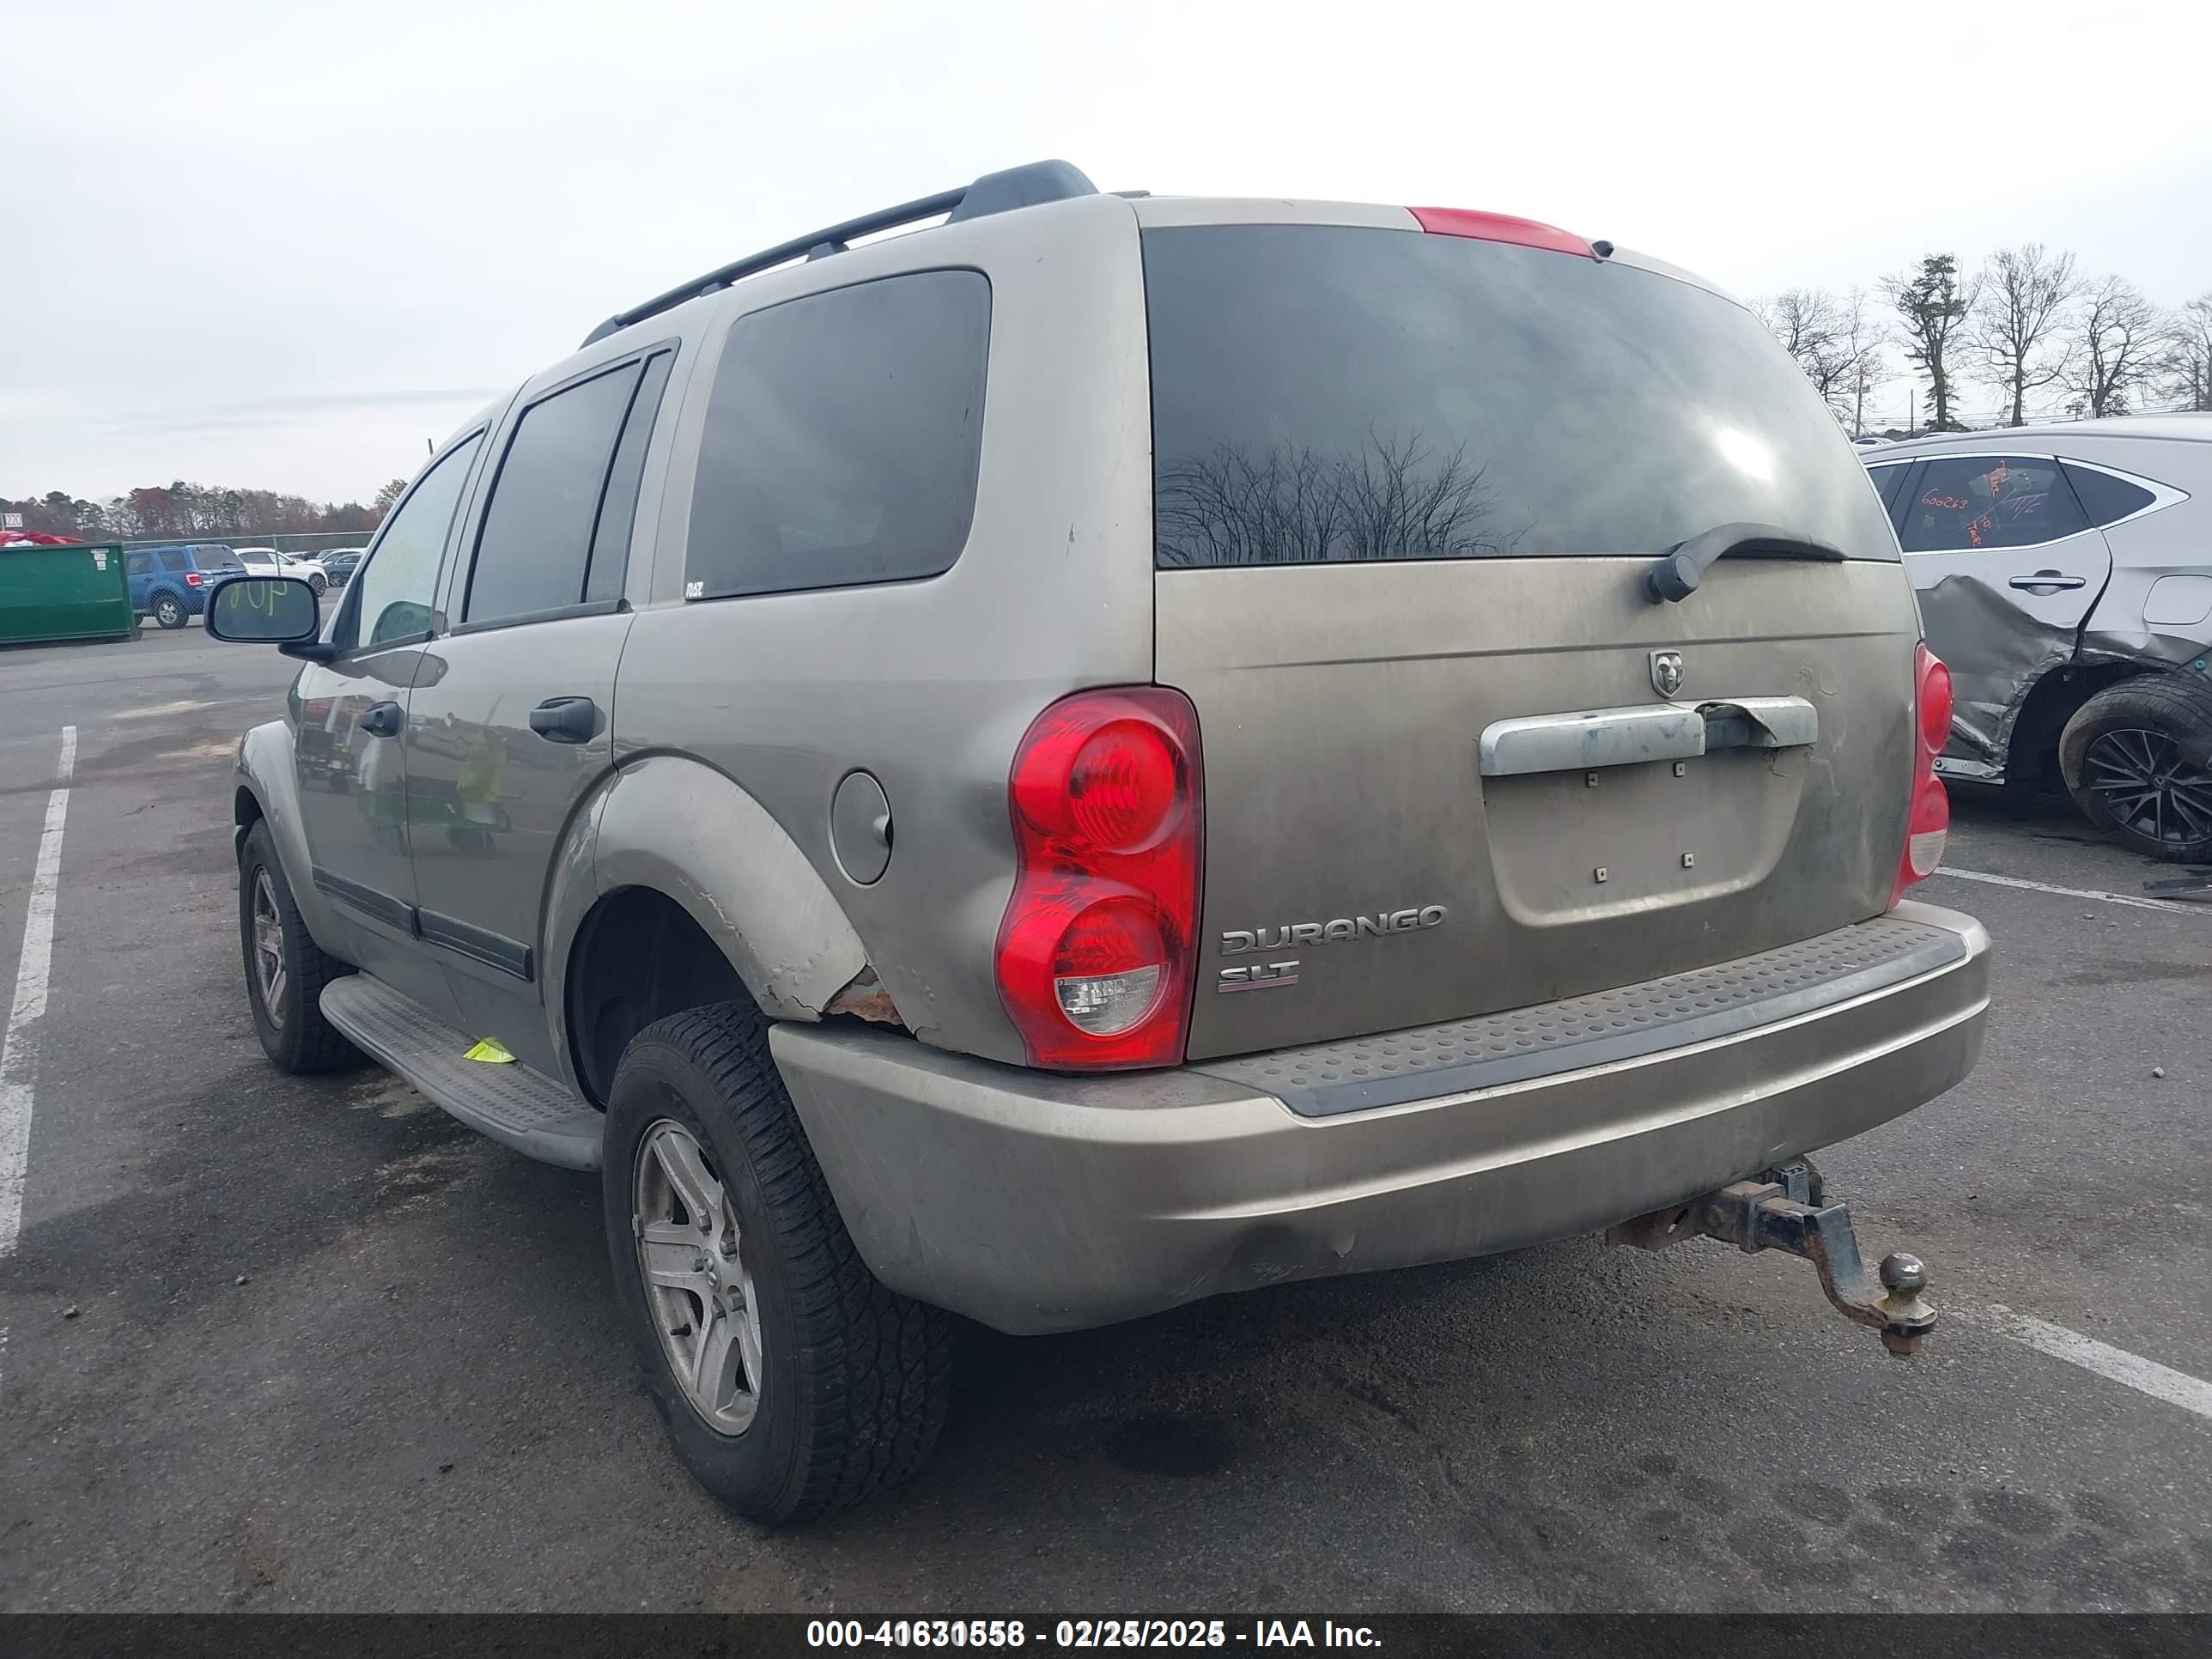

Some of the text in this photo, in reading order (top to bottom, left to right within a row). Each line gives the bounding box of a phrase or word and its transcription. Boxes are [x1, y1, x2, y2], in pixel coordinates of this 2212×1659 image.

[1922, 488, 1968, 509] 600263
[6, 514, 21, 526] 220
[1219, 904, 1449, 956] DURANGO
[1218, 961, 1300, 984] SLT
